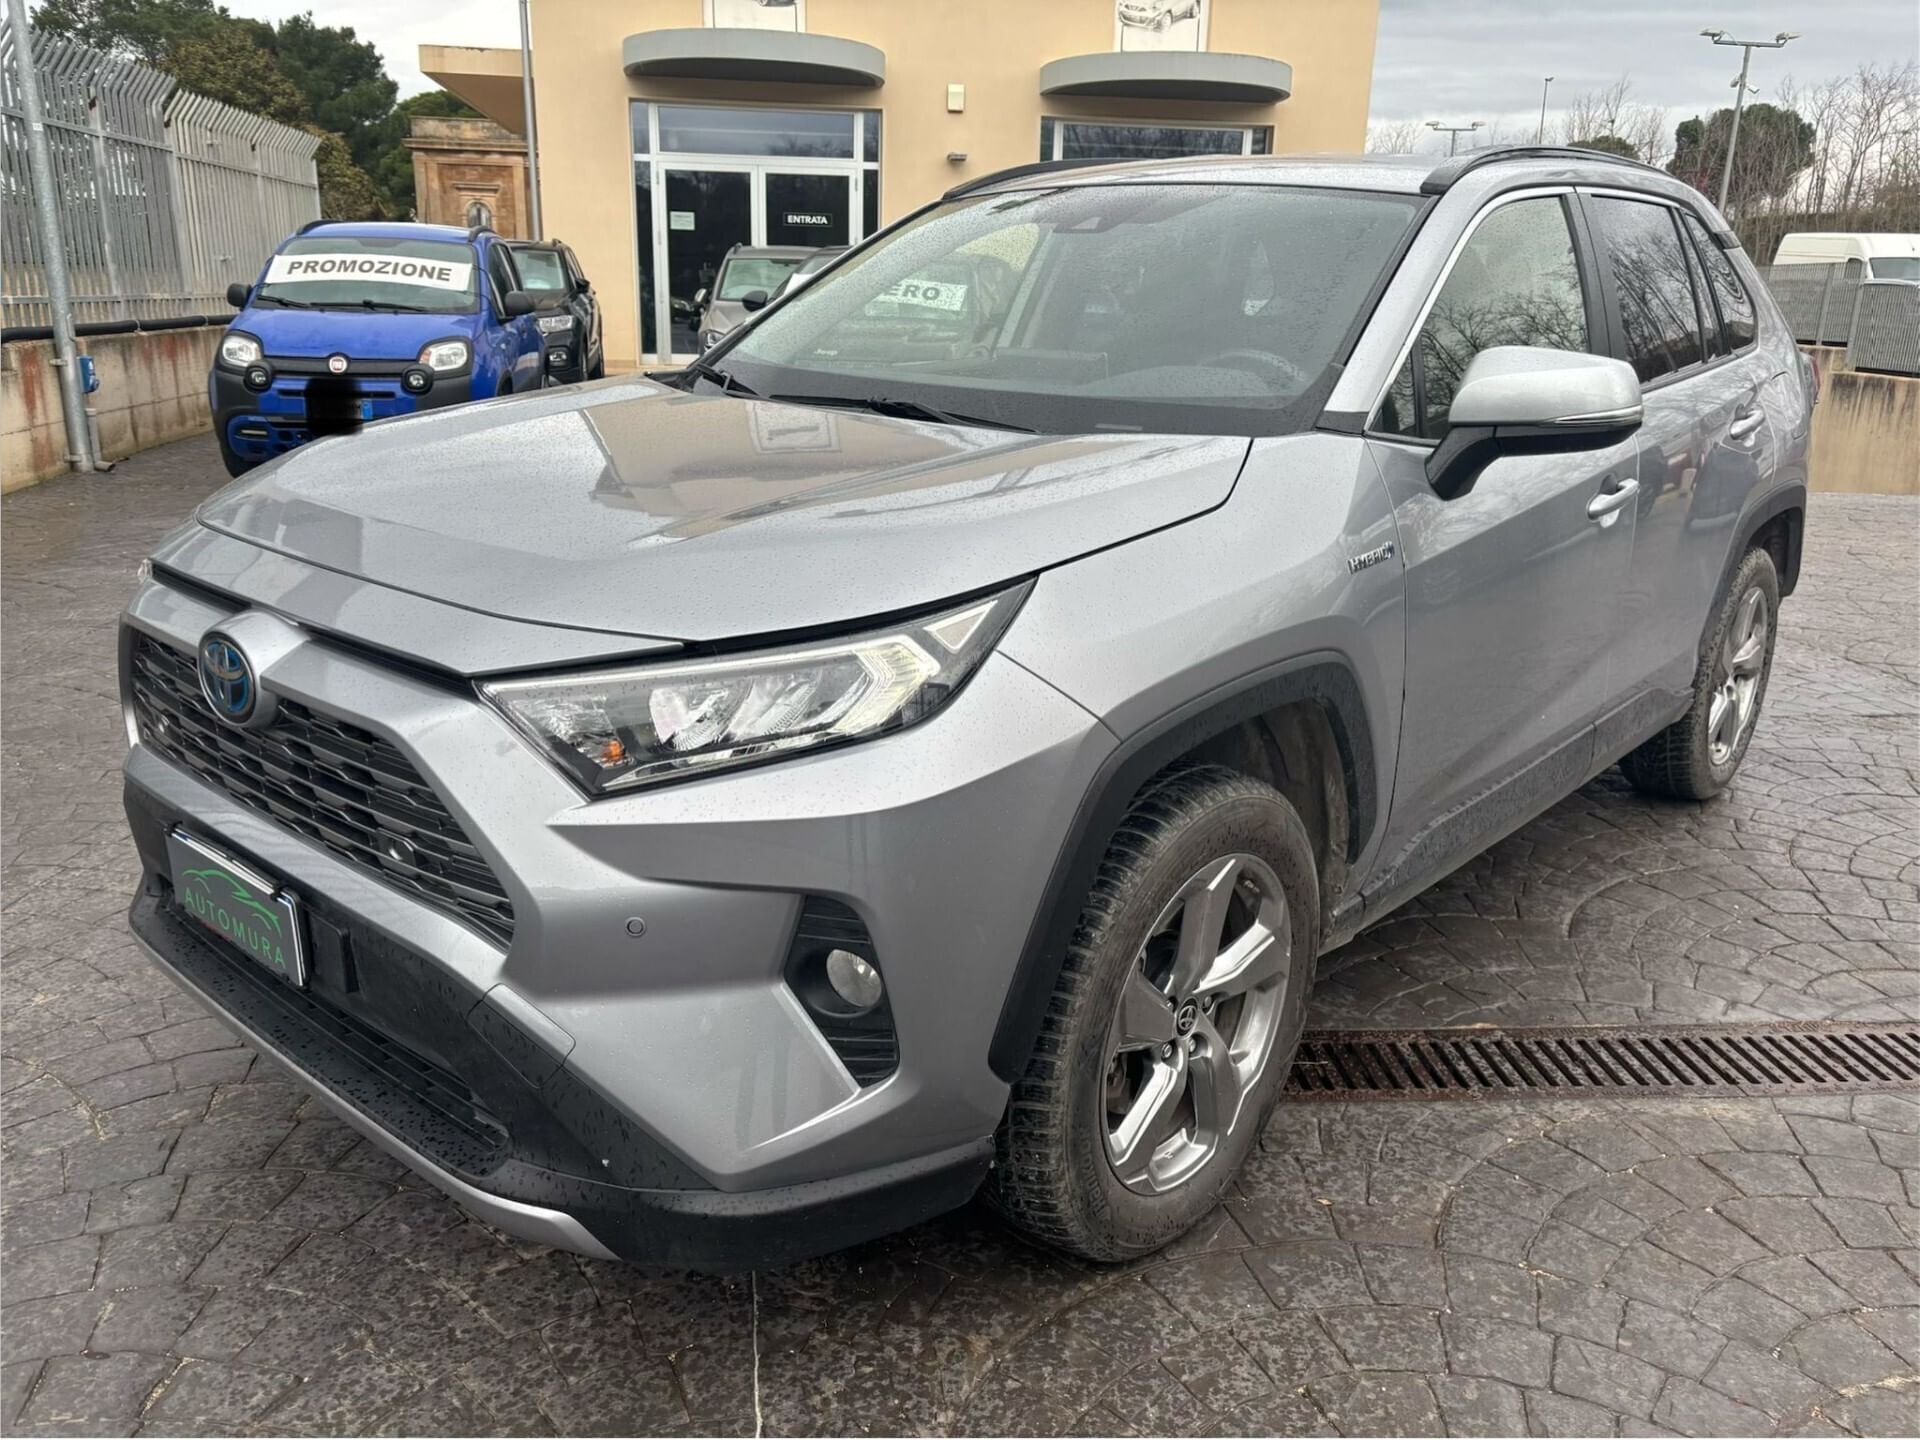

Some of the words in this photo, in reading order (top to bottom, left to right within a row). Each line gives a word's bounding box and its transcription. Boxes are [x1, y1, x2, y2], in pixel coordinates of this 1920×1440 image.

[787, 214, 828, 225] ENTRATA
[286, 259, 452, 282] PROMOZIONE
[184, 887, 287, 970] AUTOMURA
